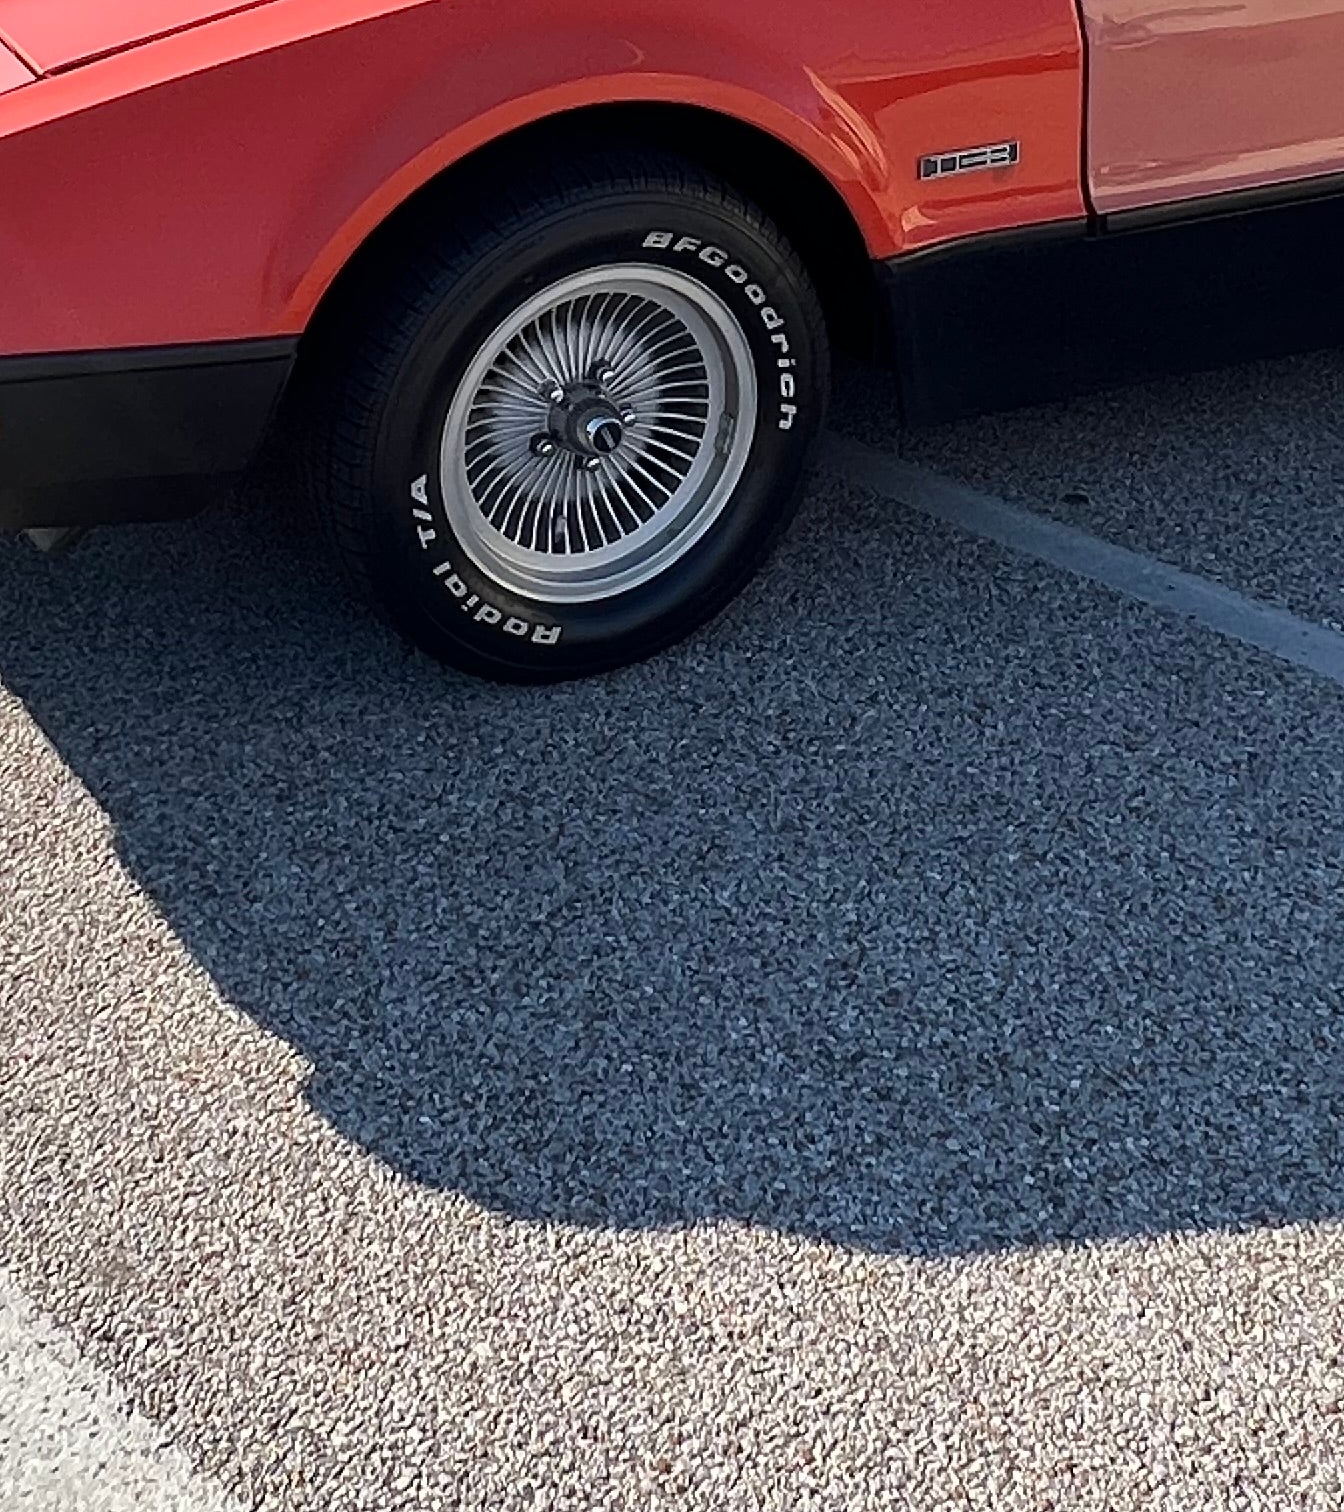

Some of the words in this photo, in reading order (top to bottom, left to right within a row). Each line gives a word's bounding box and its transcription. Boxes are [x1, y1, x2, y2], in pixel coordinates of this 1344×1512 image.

[642, 231, 797, 429] BFGoodrich
[410, 474, 436, 549] T/A
[432, 560, 562, 644] Radial
